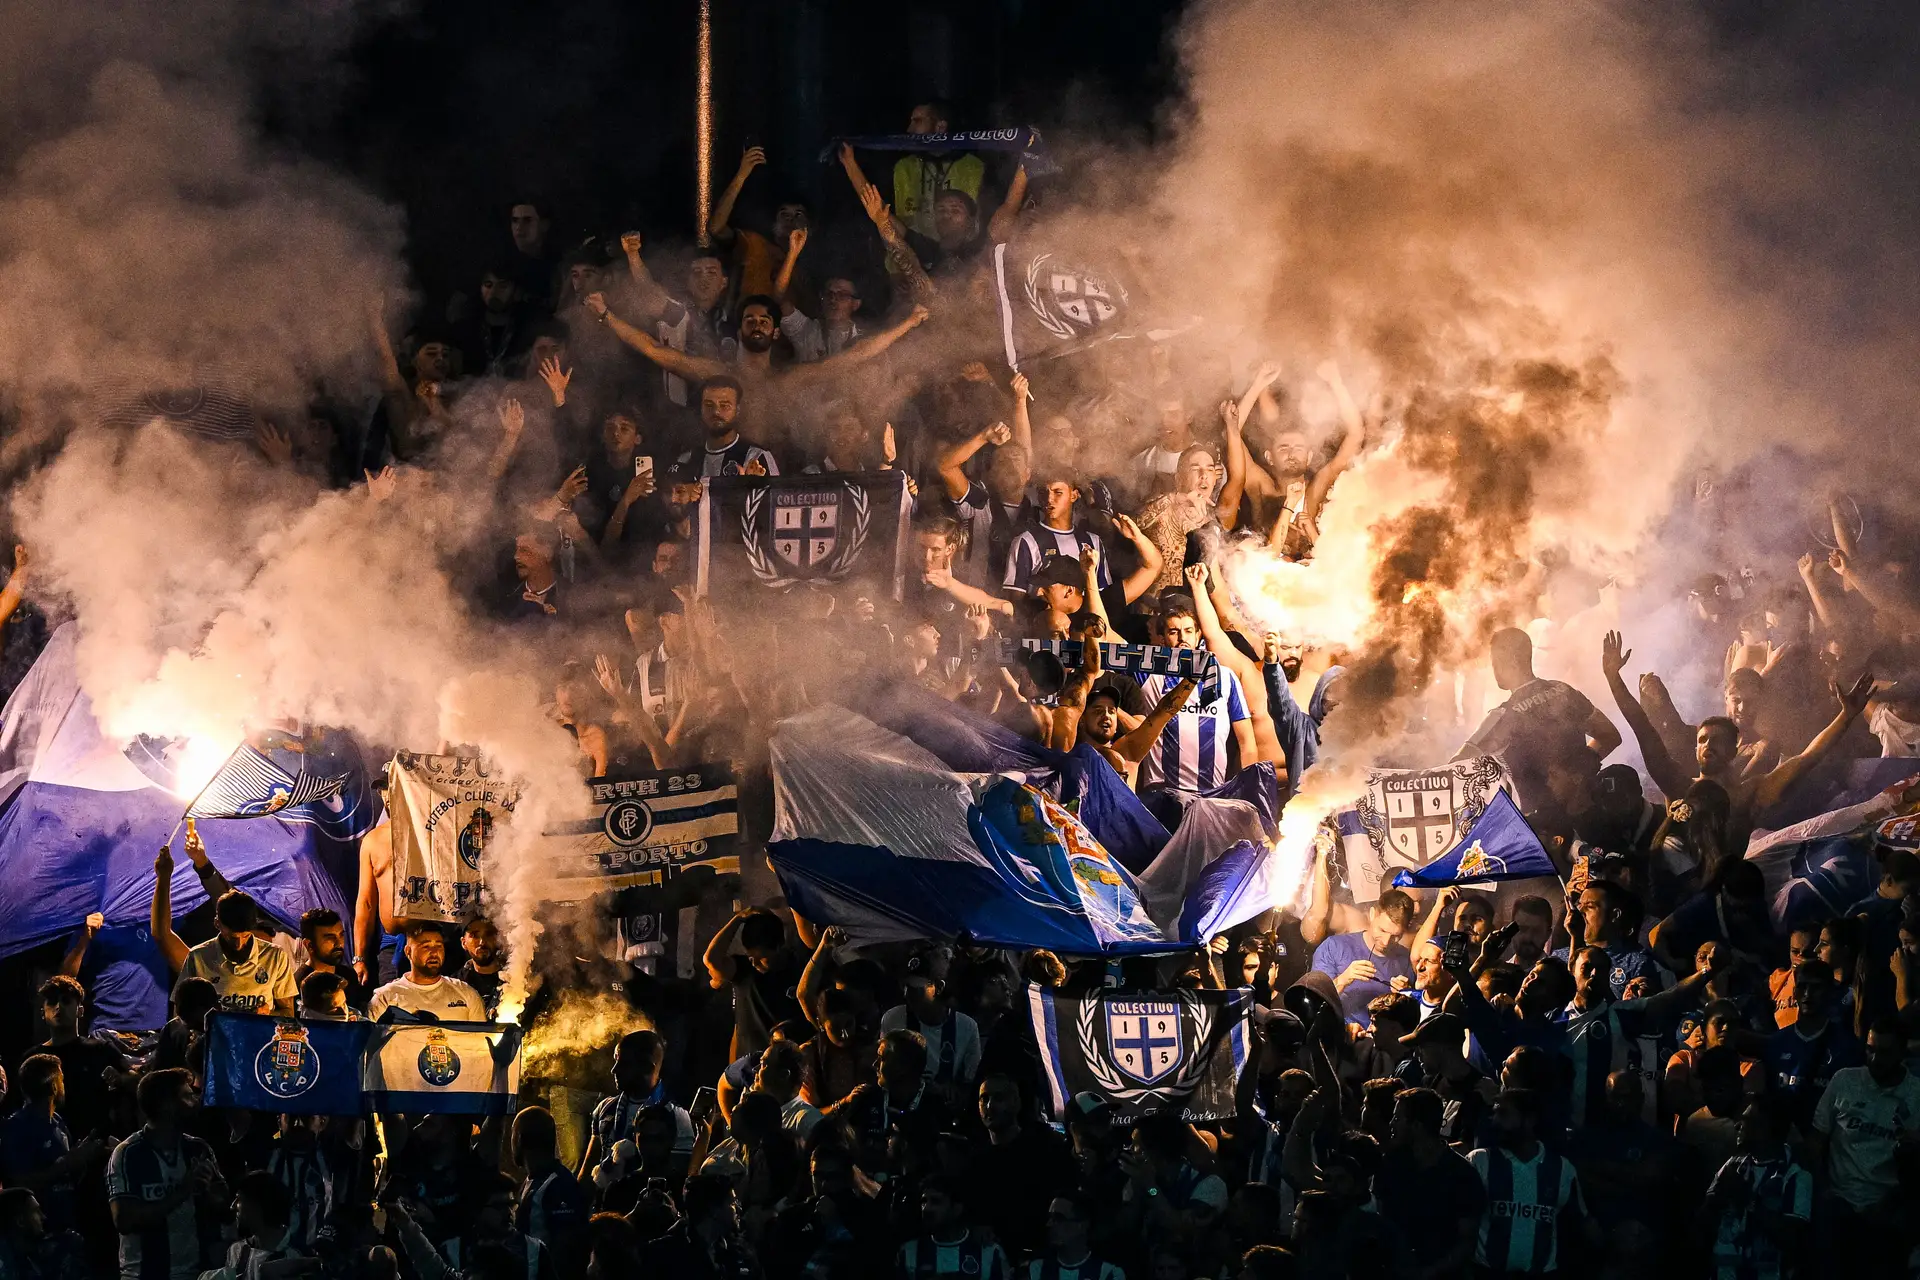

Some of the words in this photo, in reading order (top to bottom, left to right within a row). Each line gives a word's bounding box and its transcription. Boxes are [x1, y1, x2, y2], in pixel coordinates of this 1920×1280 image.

[786, 512, 790, 525] 1
[818, 510, 828, 523] 9
[783, 543, 792, 556] 9
[817, 541, 826, 555] 5
[667, 773, 702, 791] 23
[425, 795, 462, 832] FUTEBOL
[464, 790, 498, 805] CLUBE
[500, 800, 515, 813] DO
[1397, 798, 1403, 813] 1
[1432, 796, 1441, 810] 9
[1400, 833, 1409, 848] 9
[1435, 830, 1444, 845] 5
[1123, 1020, 1128, 1034] 1
[1157, 1020, 1166, 1034] 9
[1125, 1053, 1134, 1066] 9
[1160, 1051, 1169, 1064] 5
